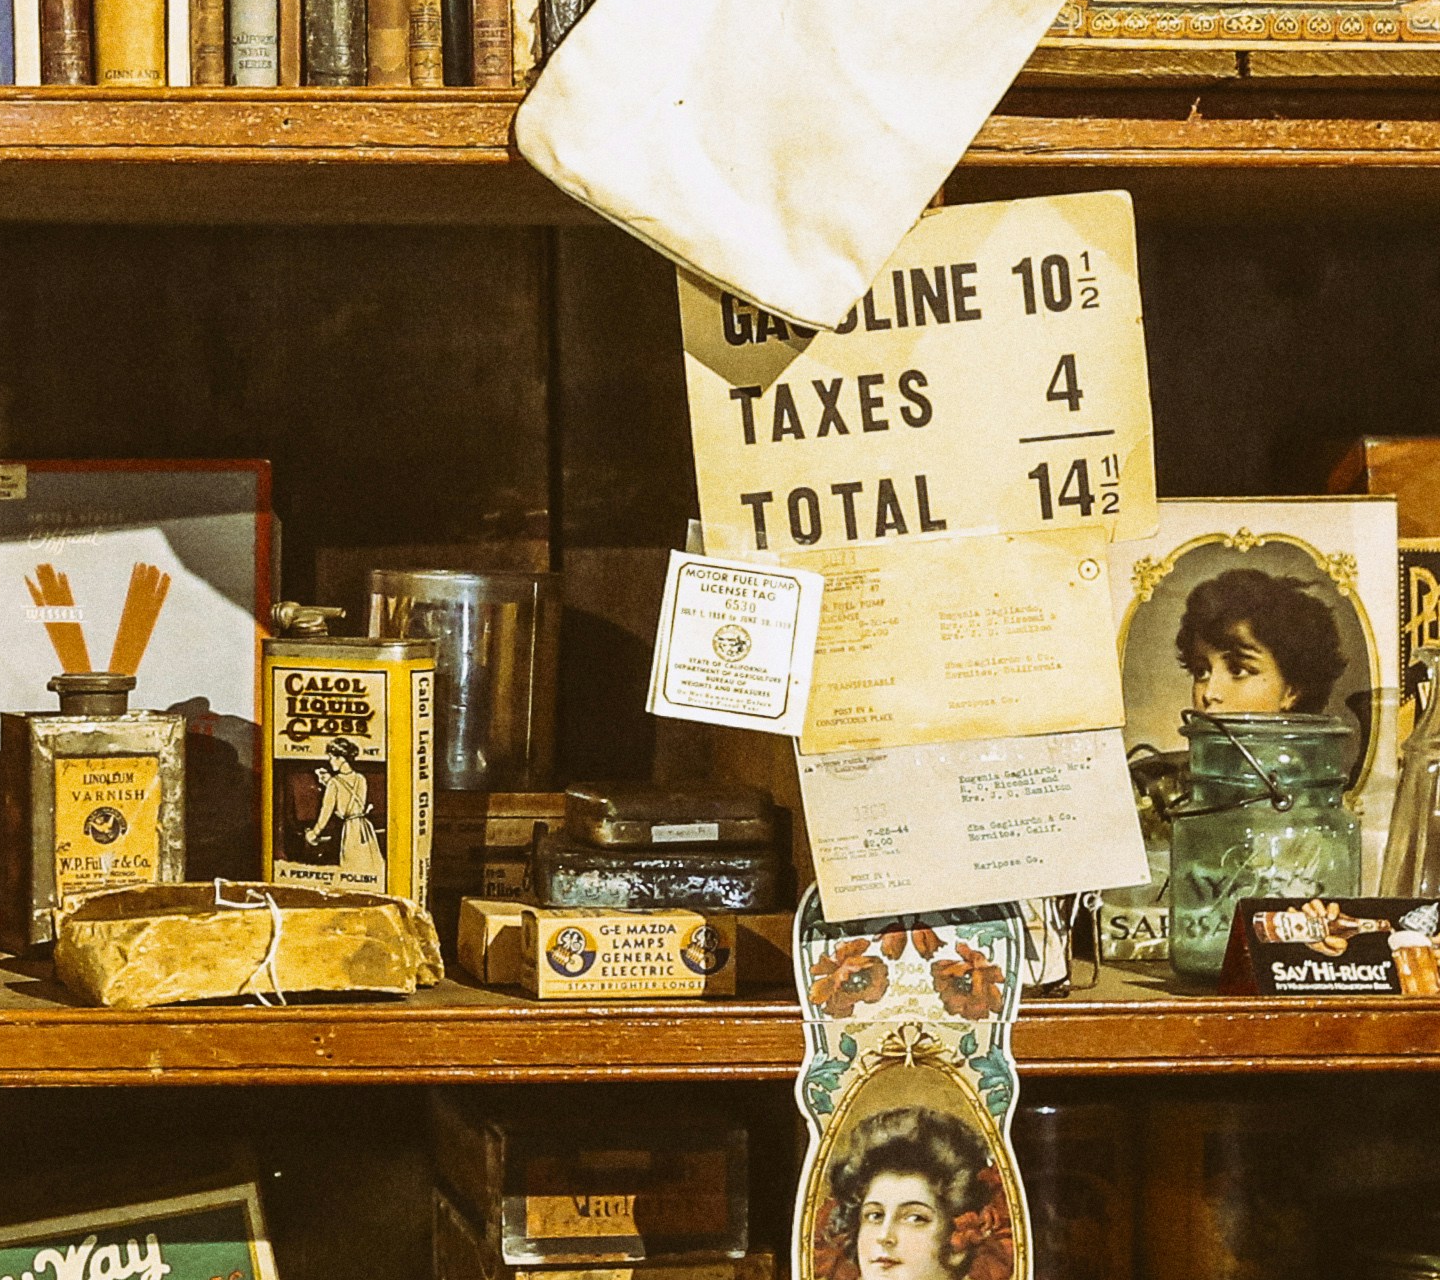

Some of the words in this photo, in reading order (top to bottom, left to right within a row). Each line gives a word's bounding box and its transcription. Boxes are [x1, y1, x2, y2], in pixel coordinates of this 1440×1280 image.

[724, 261, 981, 346] GALINE
[730, 369, 933, 445] TAXES
[1046, 353, 1084, 412] 4
[741, 473, 948, 549] TOTAL
[685, 568, 730, 583] MOTOR
[733, 572, 760, 586] FUEL
[763, 577, 796, 591] PUMP
[700, 583, 750, 598] LICENSE
[752, 589, 777, 602] TAG
[284, 673, 367, 697] CALOL
[284, 694, 375, 719] LIQUID
[82, 772, 134, 785] LINOLEUM
[70, 789, 146, 802] VARNISH
[599, 924, 619, 936] G-E
[626, 924, 677, 936] MAZDA
[612, 938, 664, 949] LAMPS
[601, 951, 674, 963] GENERAL
[601, 965, 675, 977] ELECTRIC
